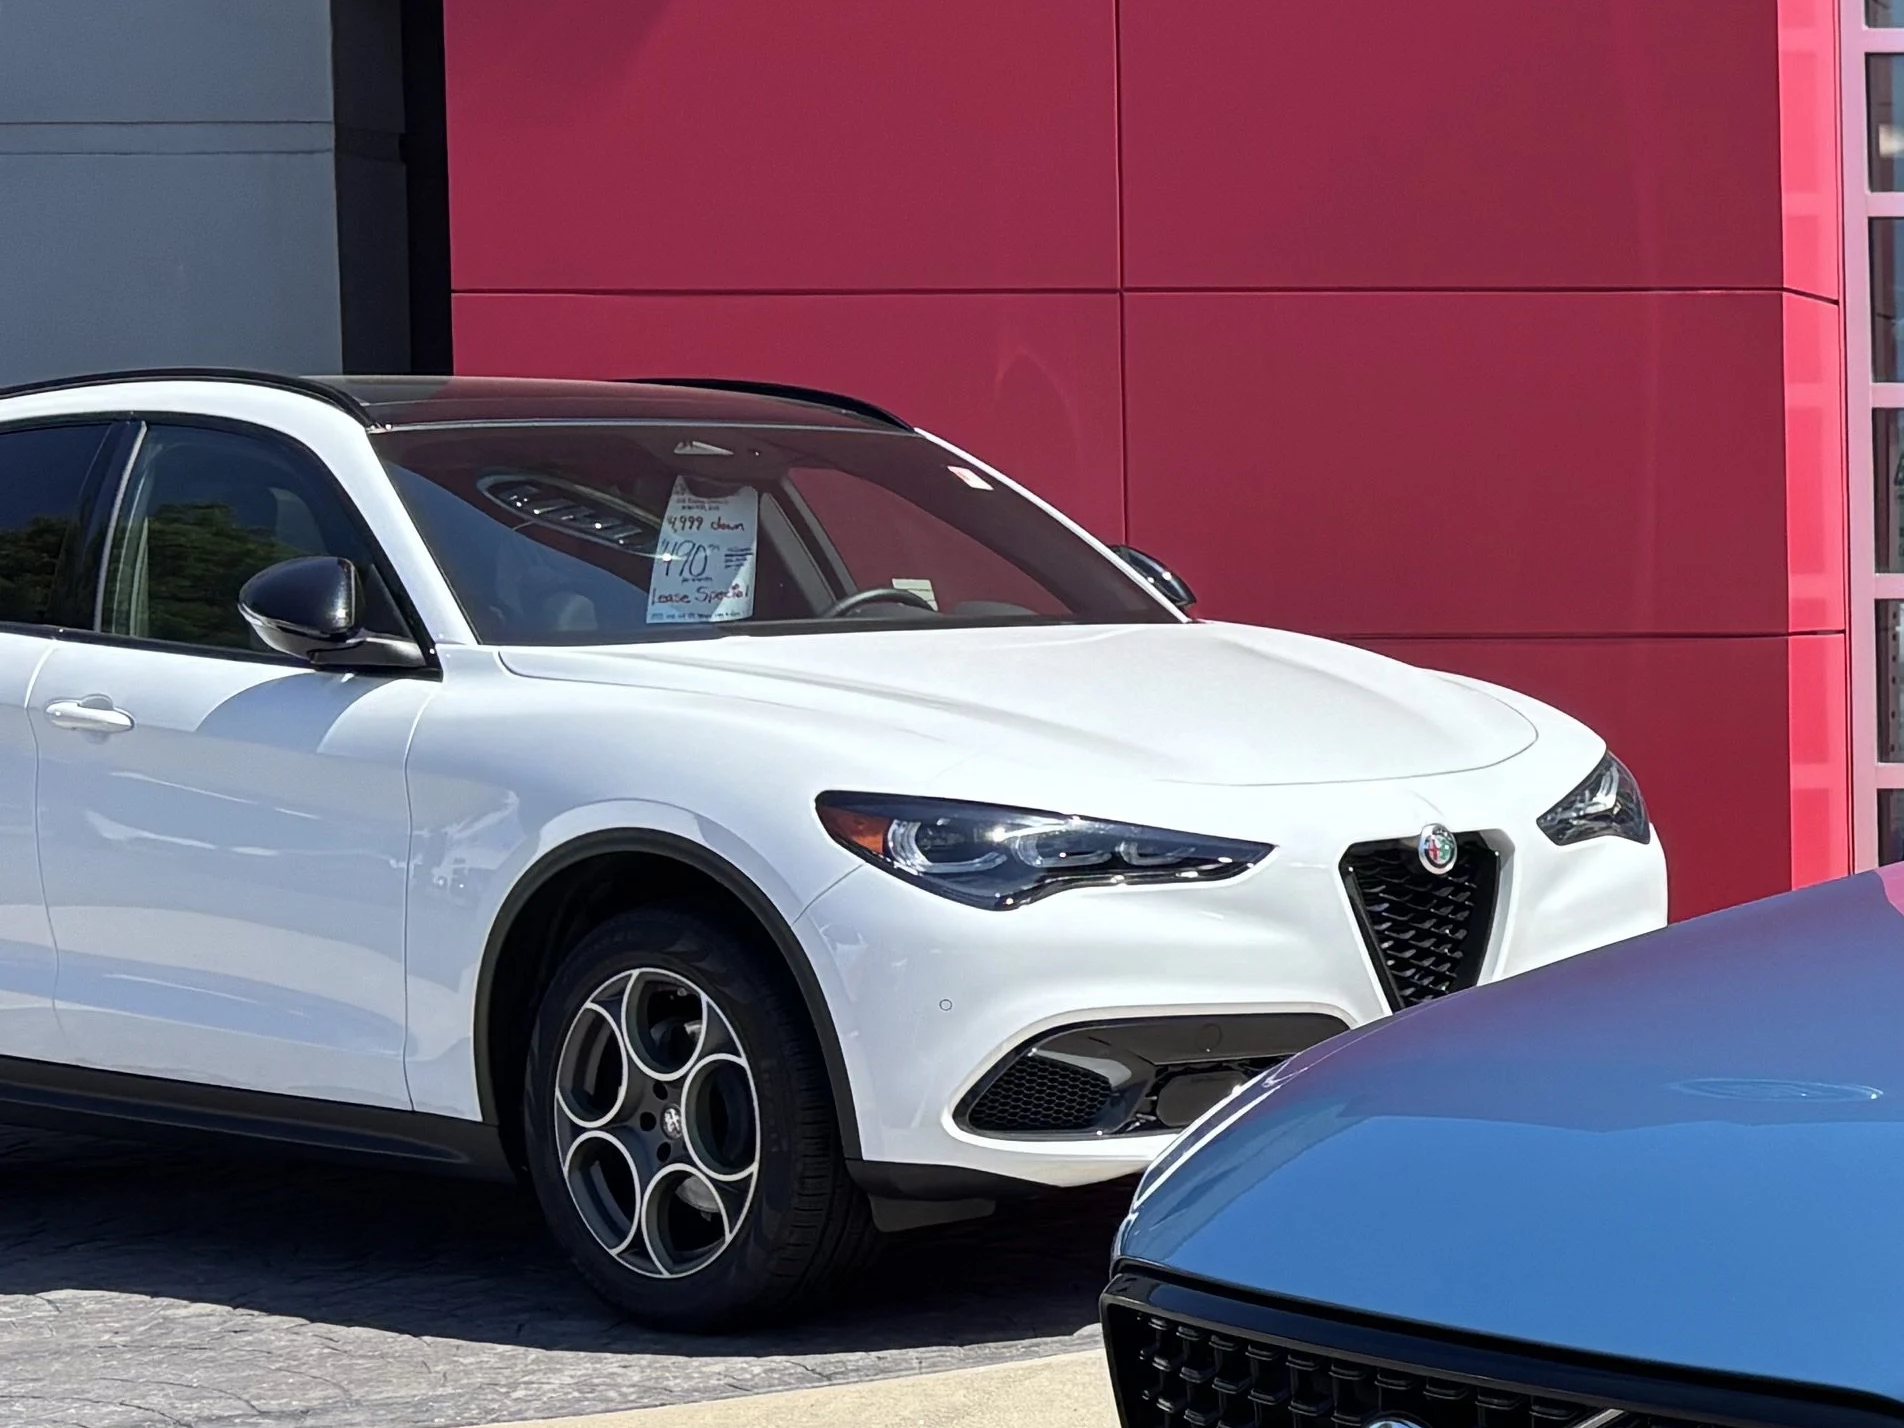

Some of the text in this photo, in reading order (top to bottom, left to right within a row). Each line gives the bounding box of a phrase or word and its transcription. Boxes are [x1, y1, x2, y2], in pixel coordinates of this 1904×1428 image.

[710, 516, 745, 532] down
[650, 578, 749, 606] Lease Special
